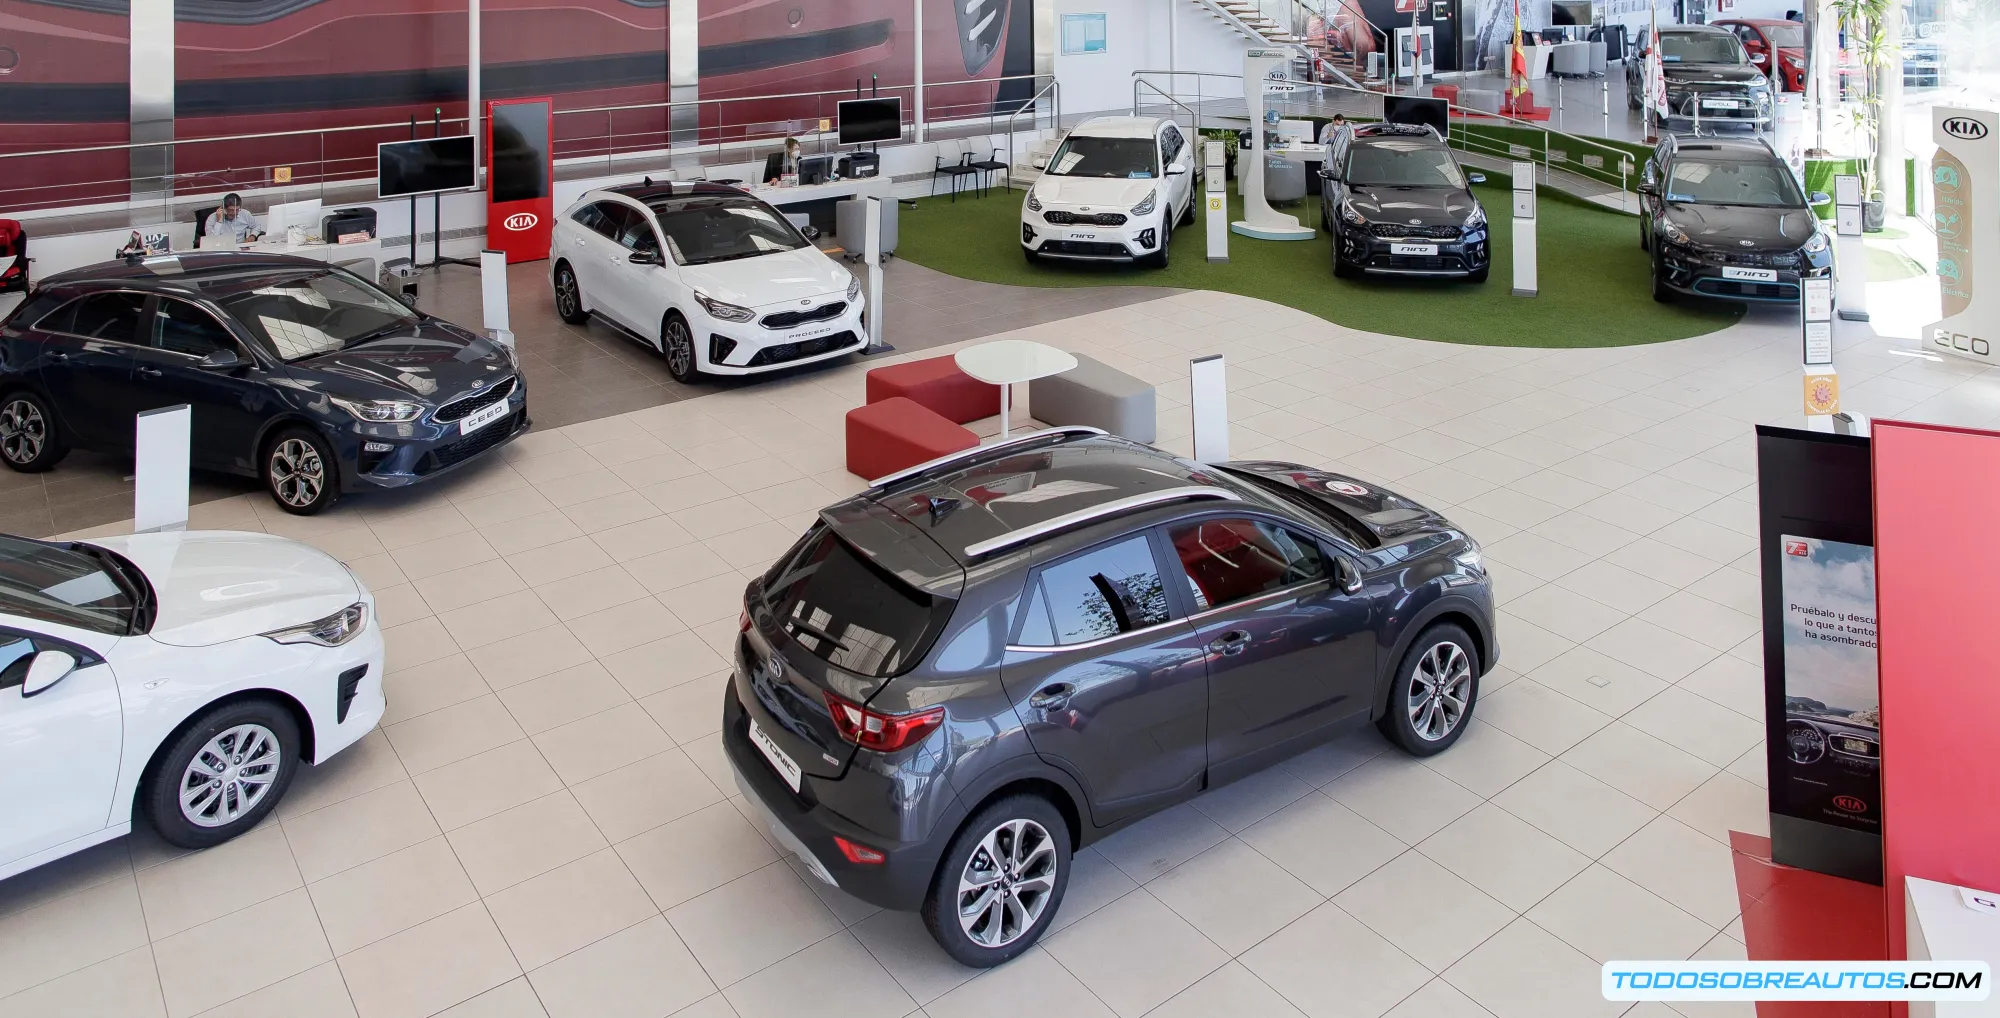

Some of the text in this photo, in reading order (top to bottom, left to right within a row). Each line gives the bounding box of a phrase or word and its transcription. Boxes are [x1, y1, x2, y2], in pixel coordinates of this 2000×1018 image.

[1949, 120, 1981, 136] KIA
[510, 216, 533, 228] KIA
[789, 327, 831, 339] PROCEED
[468, 406, 503, 428] CEED
[1790, 604, 1877, 625] Pruébalo y descu
[1804, 618, 1814, 627] lo
[1816, 621, 1835, 630] que
[1805, 630, 1877, 649] ha asombrado
[755, 726, 797, 777] STONIC
[1839, 798, 1862, 810] KIA
